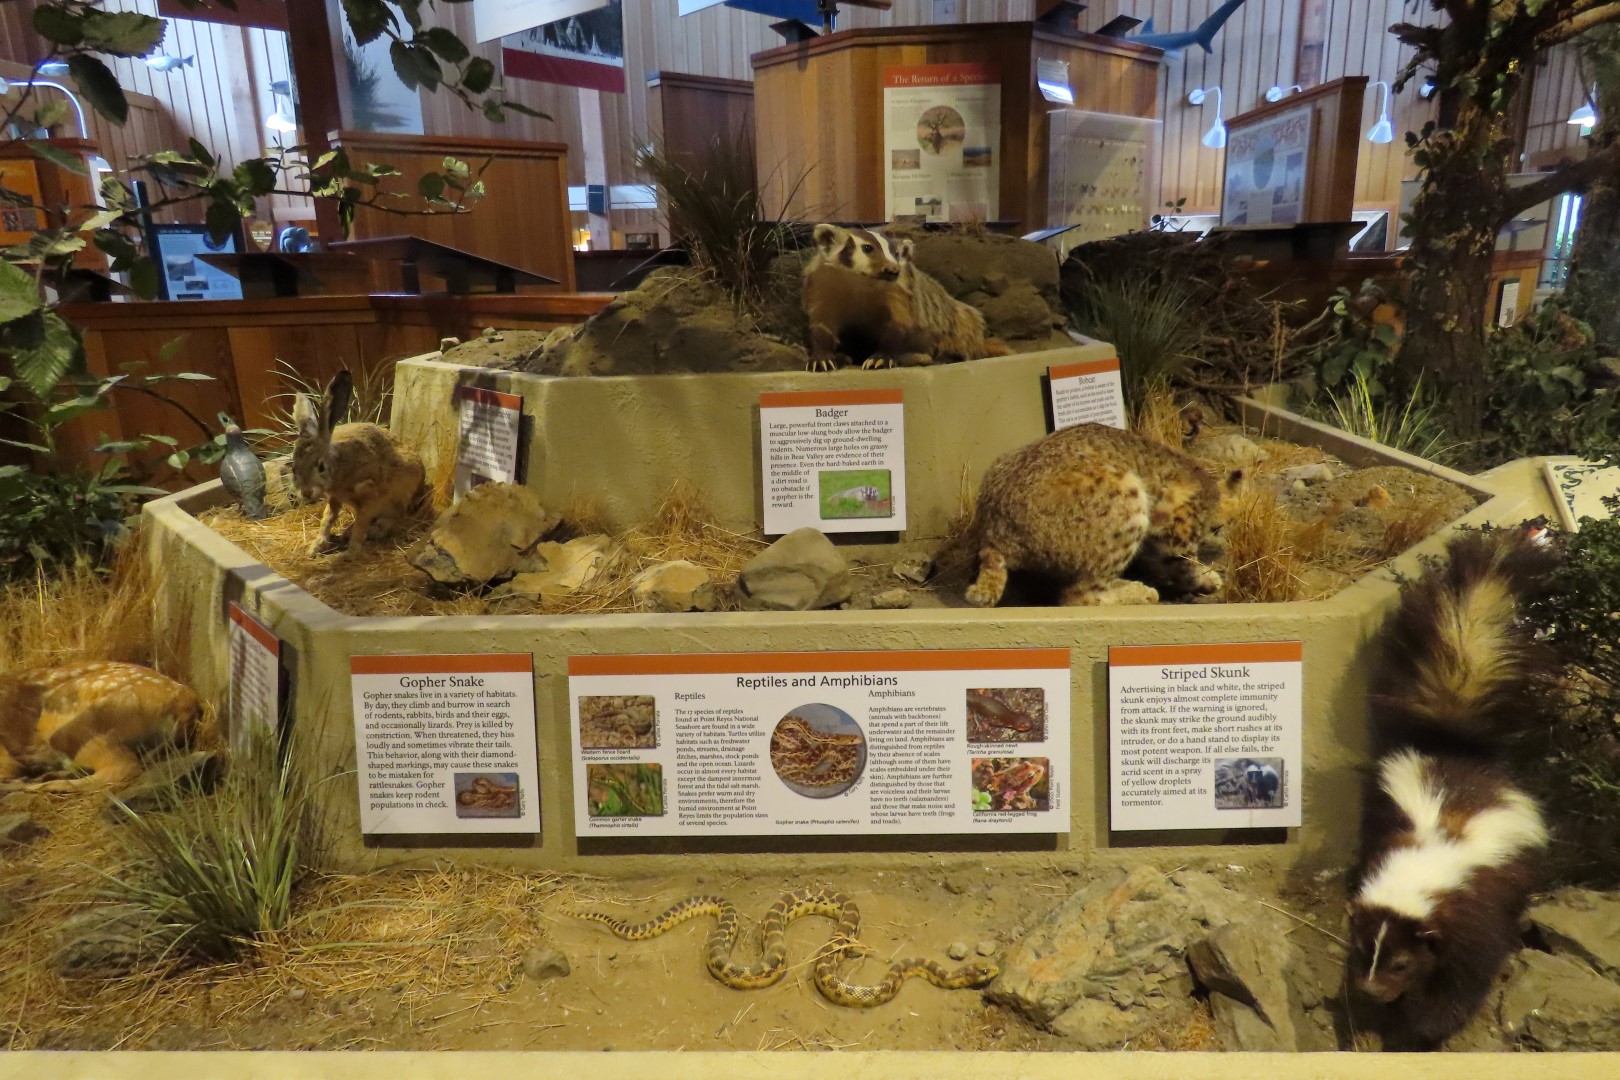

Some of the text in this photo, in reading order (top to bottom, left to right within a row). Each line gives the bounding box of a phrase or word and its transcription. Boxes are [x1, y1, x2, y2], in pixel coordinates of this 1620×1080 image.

[1078, 376, 1096, 385] Bobcat
[816, 408, 848, 419] Badger
[789, 422, 816, 430] powerful
[798, 429, 826, 437] low-slung
[828, 428, 842, 436] body
[872, 427, 893, 435] badger
[777, 437, 811, 446] aggressively
[813, 437, 822, 445] dig
[832, 436, 882, 445] ground-dwelling
[828, 444, 842, 453] large
[1161, 667, 1250, 682] Striped Skunk
[400, 676, 484, 690] Gopher Snake
[737, 675, 897, 689] Reptiles and Amphibians
[868, 689, 915, 699] Amphibians
[1120, 685, 1165, 696] Advertising
[1167, 684, 1175, 692] in
[1177, 684, 1198, 692] black
[1217, 683, 1241, 692] white,
[1257, 682, 1285, 692] striped
[364, 691, 392, 701] Gopher
[450, 691, 474, 700] variety
[675, 692, 706, 702] Reptiles
[1120, 693, 1278, 705] skunk enjoys almost complete immunity
[364, 702, 373, 711] By
[375, 702, 390, 711] day,
[391, 701, 407, 711] they
[869, 706, 903, 714] Amphibians
[1142, 705, 1168, 713] attack.
[1193, 704, 1225, 715] warning
[1235, 704, 1267, 714] ignored,
[375, 711, 405, 720] rodents,
[406, 711, 434, 720] rabbits,
[694, 708, 714, 716] species
[723, 708, 744, 716] reptiles
[717, 715, 733, 723] Reyes
[1120, 716, 1133, 724] the
[1161, 718, 1176, 726] may
[1179, 715, 1200, 723] strike
[1217, 714, 1246, 725] ground
[1248, 714, 1277, 724] audibly
[381, 721, 426, 731] occasionally
[456, 721, 472, 730] Prey
[505, 721, 513, 730] by
[881, 721, 898, 729] spend
[366, 731, 412, 739] constriction.
[438, 731, 480, 739] threatened,
[483, 731, 498, 740] they
